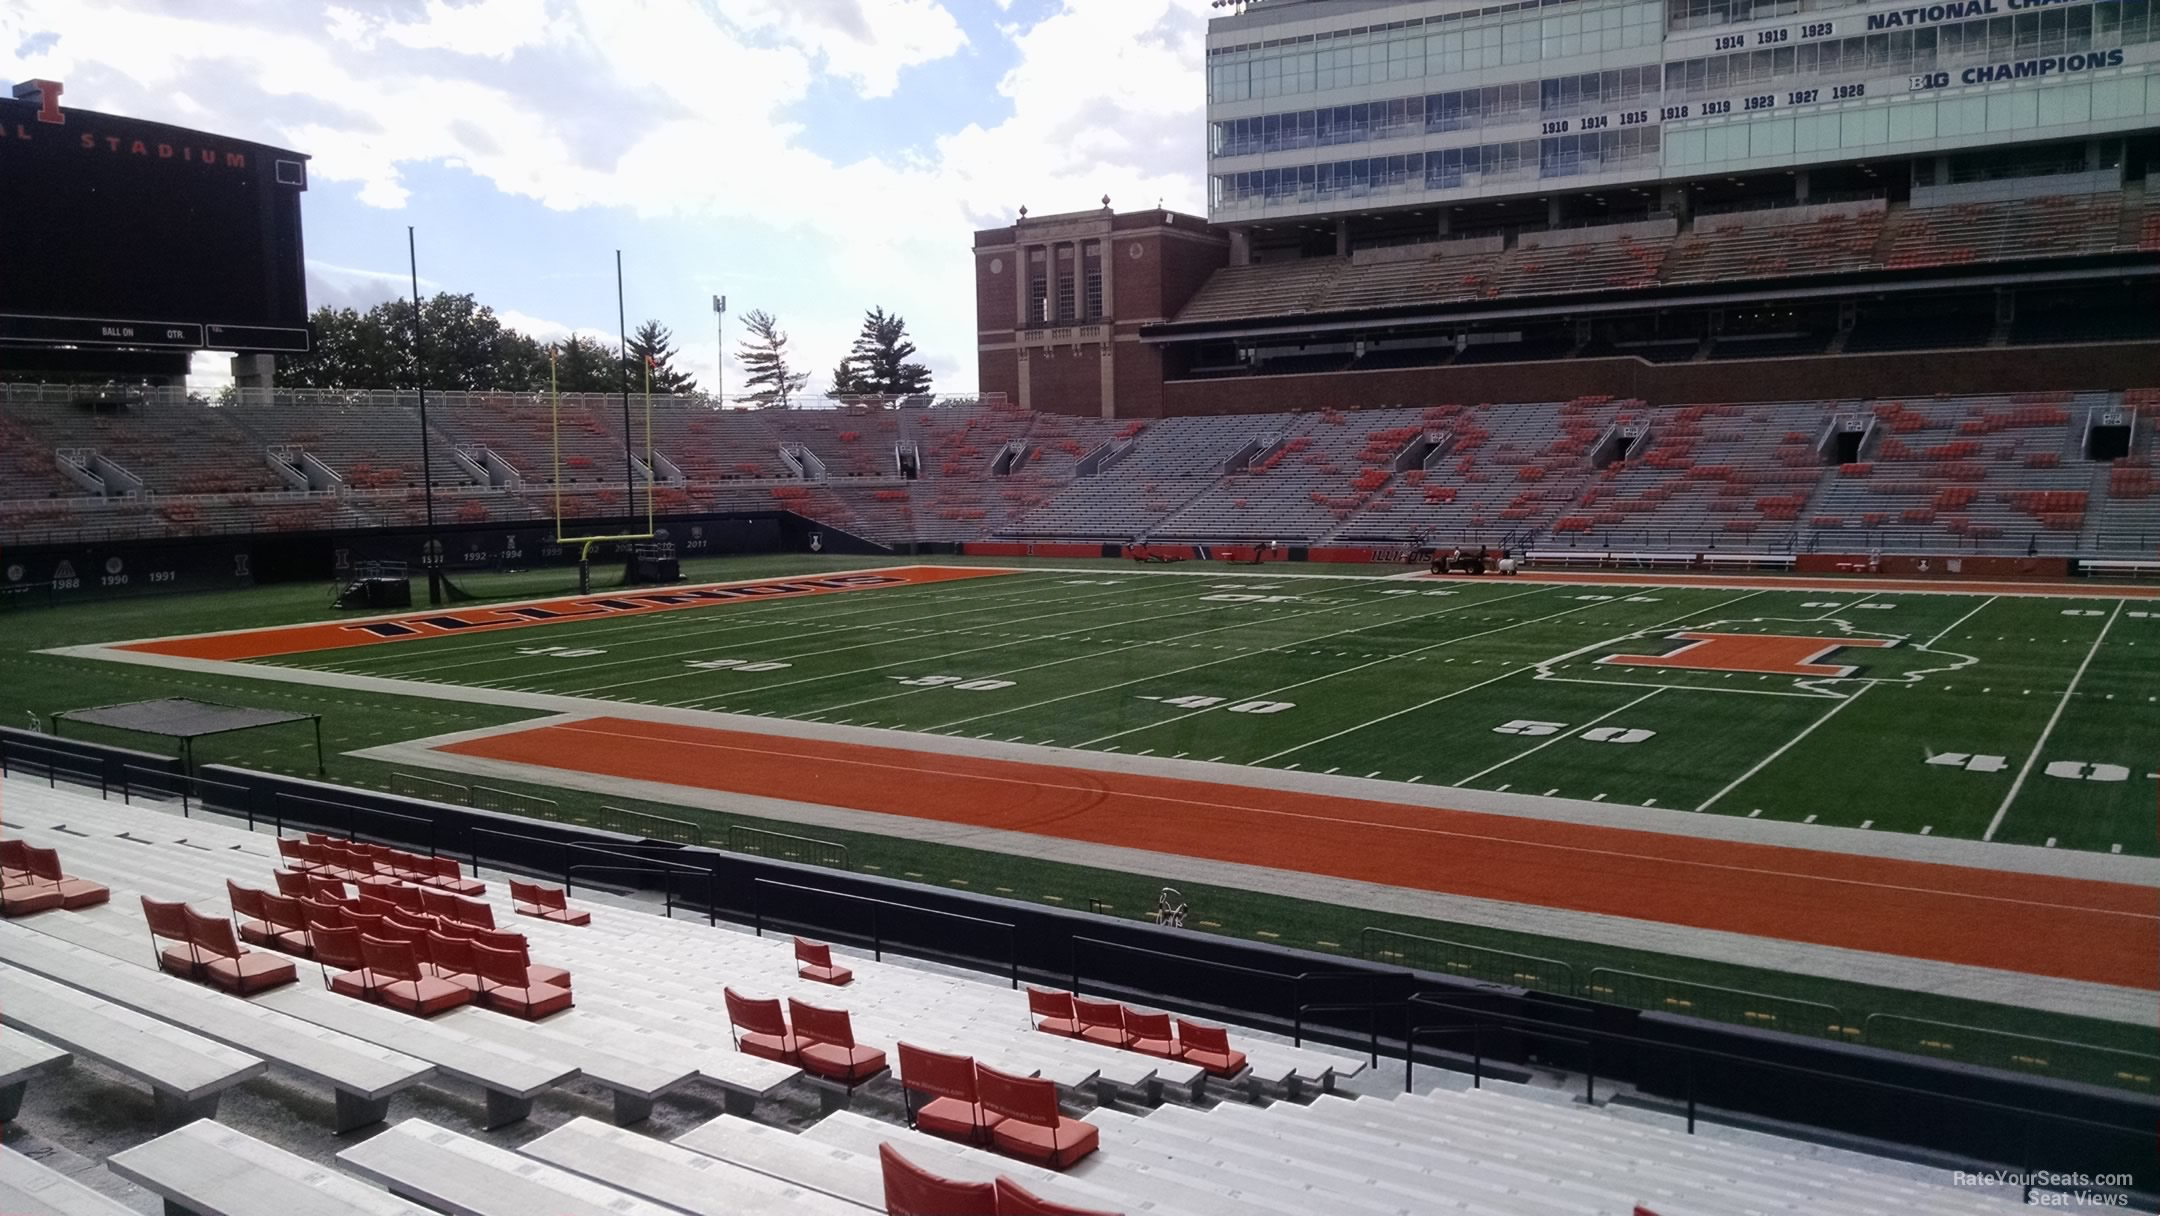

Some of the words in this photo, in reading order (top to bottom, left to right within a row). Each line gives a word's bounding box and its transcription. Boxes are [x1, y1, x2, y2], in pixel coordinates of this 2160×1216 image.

[1867, 0, 1998, 30] NATIONAL
[1715, 34, 1745, 50] 1914
[1757, 28, 1788, 45] 1919
[1801, 22, 1833, 39] 1923
[1961, 49, 2124, 84] CHAMPIONS
[1542, 121, 1569, 135] 1910
[1581, 116, 1608, 130] 1914
[1620, 111, 1648, 126] 1915
[1660, 106, 1689, 121] 1918
[1701, 101, 1731, 116] 1919
[1744, 95, 1775, 111] 1923
[1788, 90, 1819, 105] 1927
[1832, 84, 1865, 100] 1928
[81, 132, 245, 168] STADIUM
[102, 326, 121, 337] BALL
[122, 327, 134, 338] ON
[464, 551, 487, 561] 1992
[578, 545, 600, 555] 202
[686, 540, 708, 550] 2011
[1371, 550, 1433, 563] ILLIOIS
[51, 578, 80, 590] 1988
[100, 574, 129, 586] 1990
[149, 570, 176, 582] 1991
[899, 675, 1017, 691] 30
[1492, 718, 1657, 744] 50
[1924, 751, 2131, 783] 40
